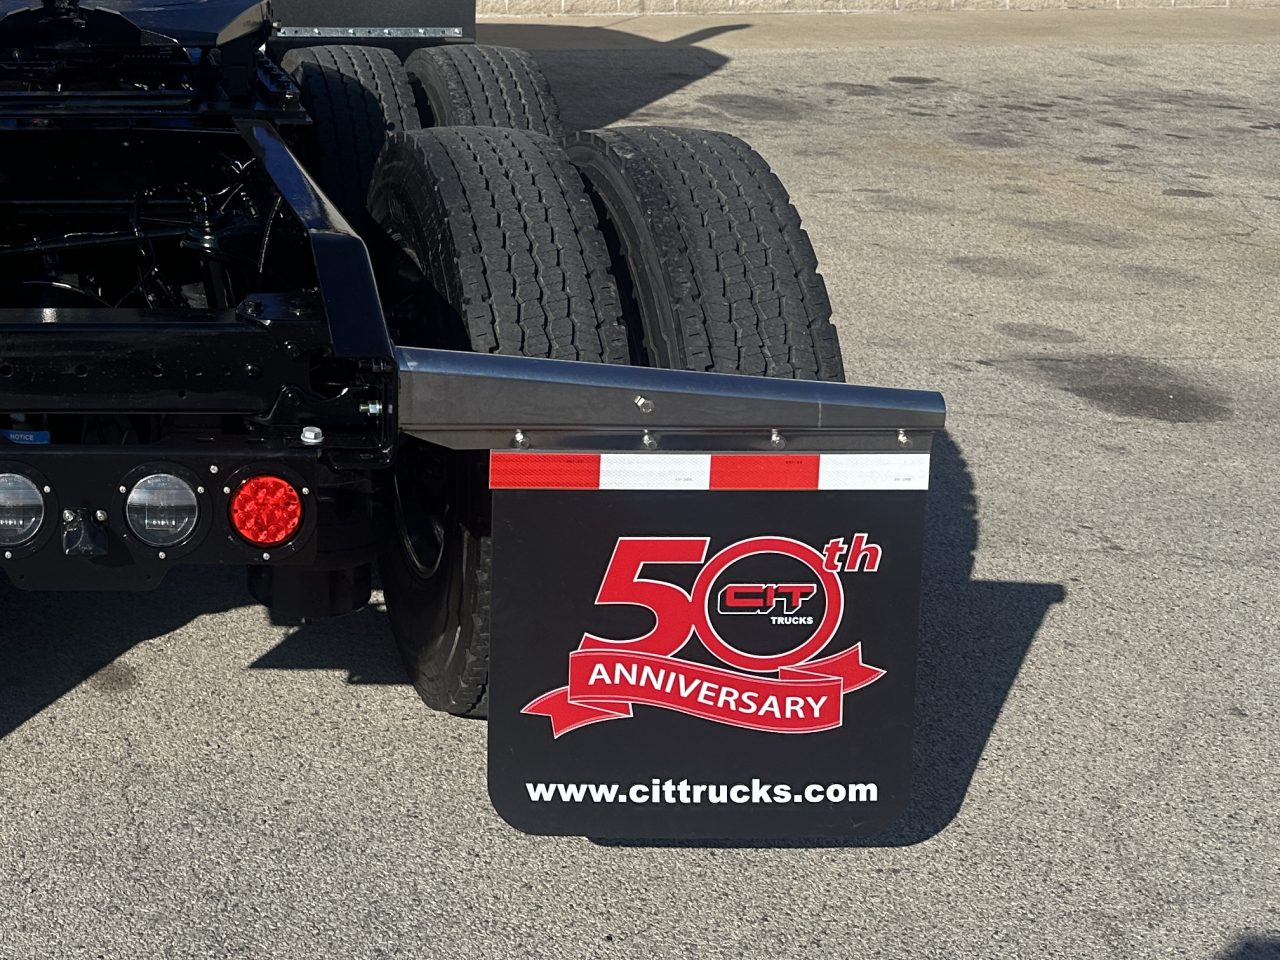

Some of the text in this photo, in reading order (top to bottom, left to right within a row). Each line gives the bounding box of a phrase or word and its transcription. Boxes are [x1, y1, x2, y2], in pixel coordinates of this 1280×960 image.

[717, 583, 817, 615] CIT
[770, 616, 814, 625] TRUCKS
[587, 662, 829, 719] ANNIVERSARY
[525, 778, 879, 803] www.cittrucks.com
